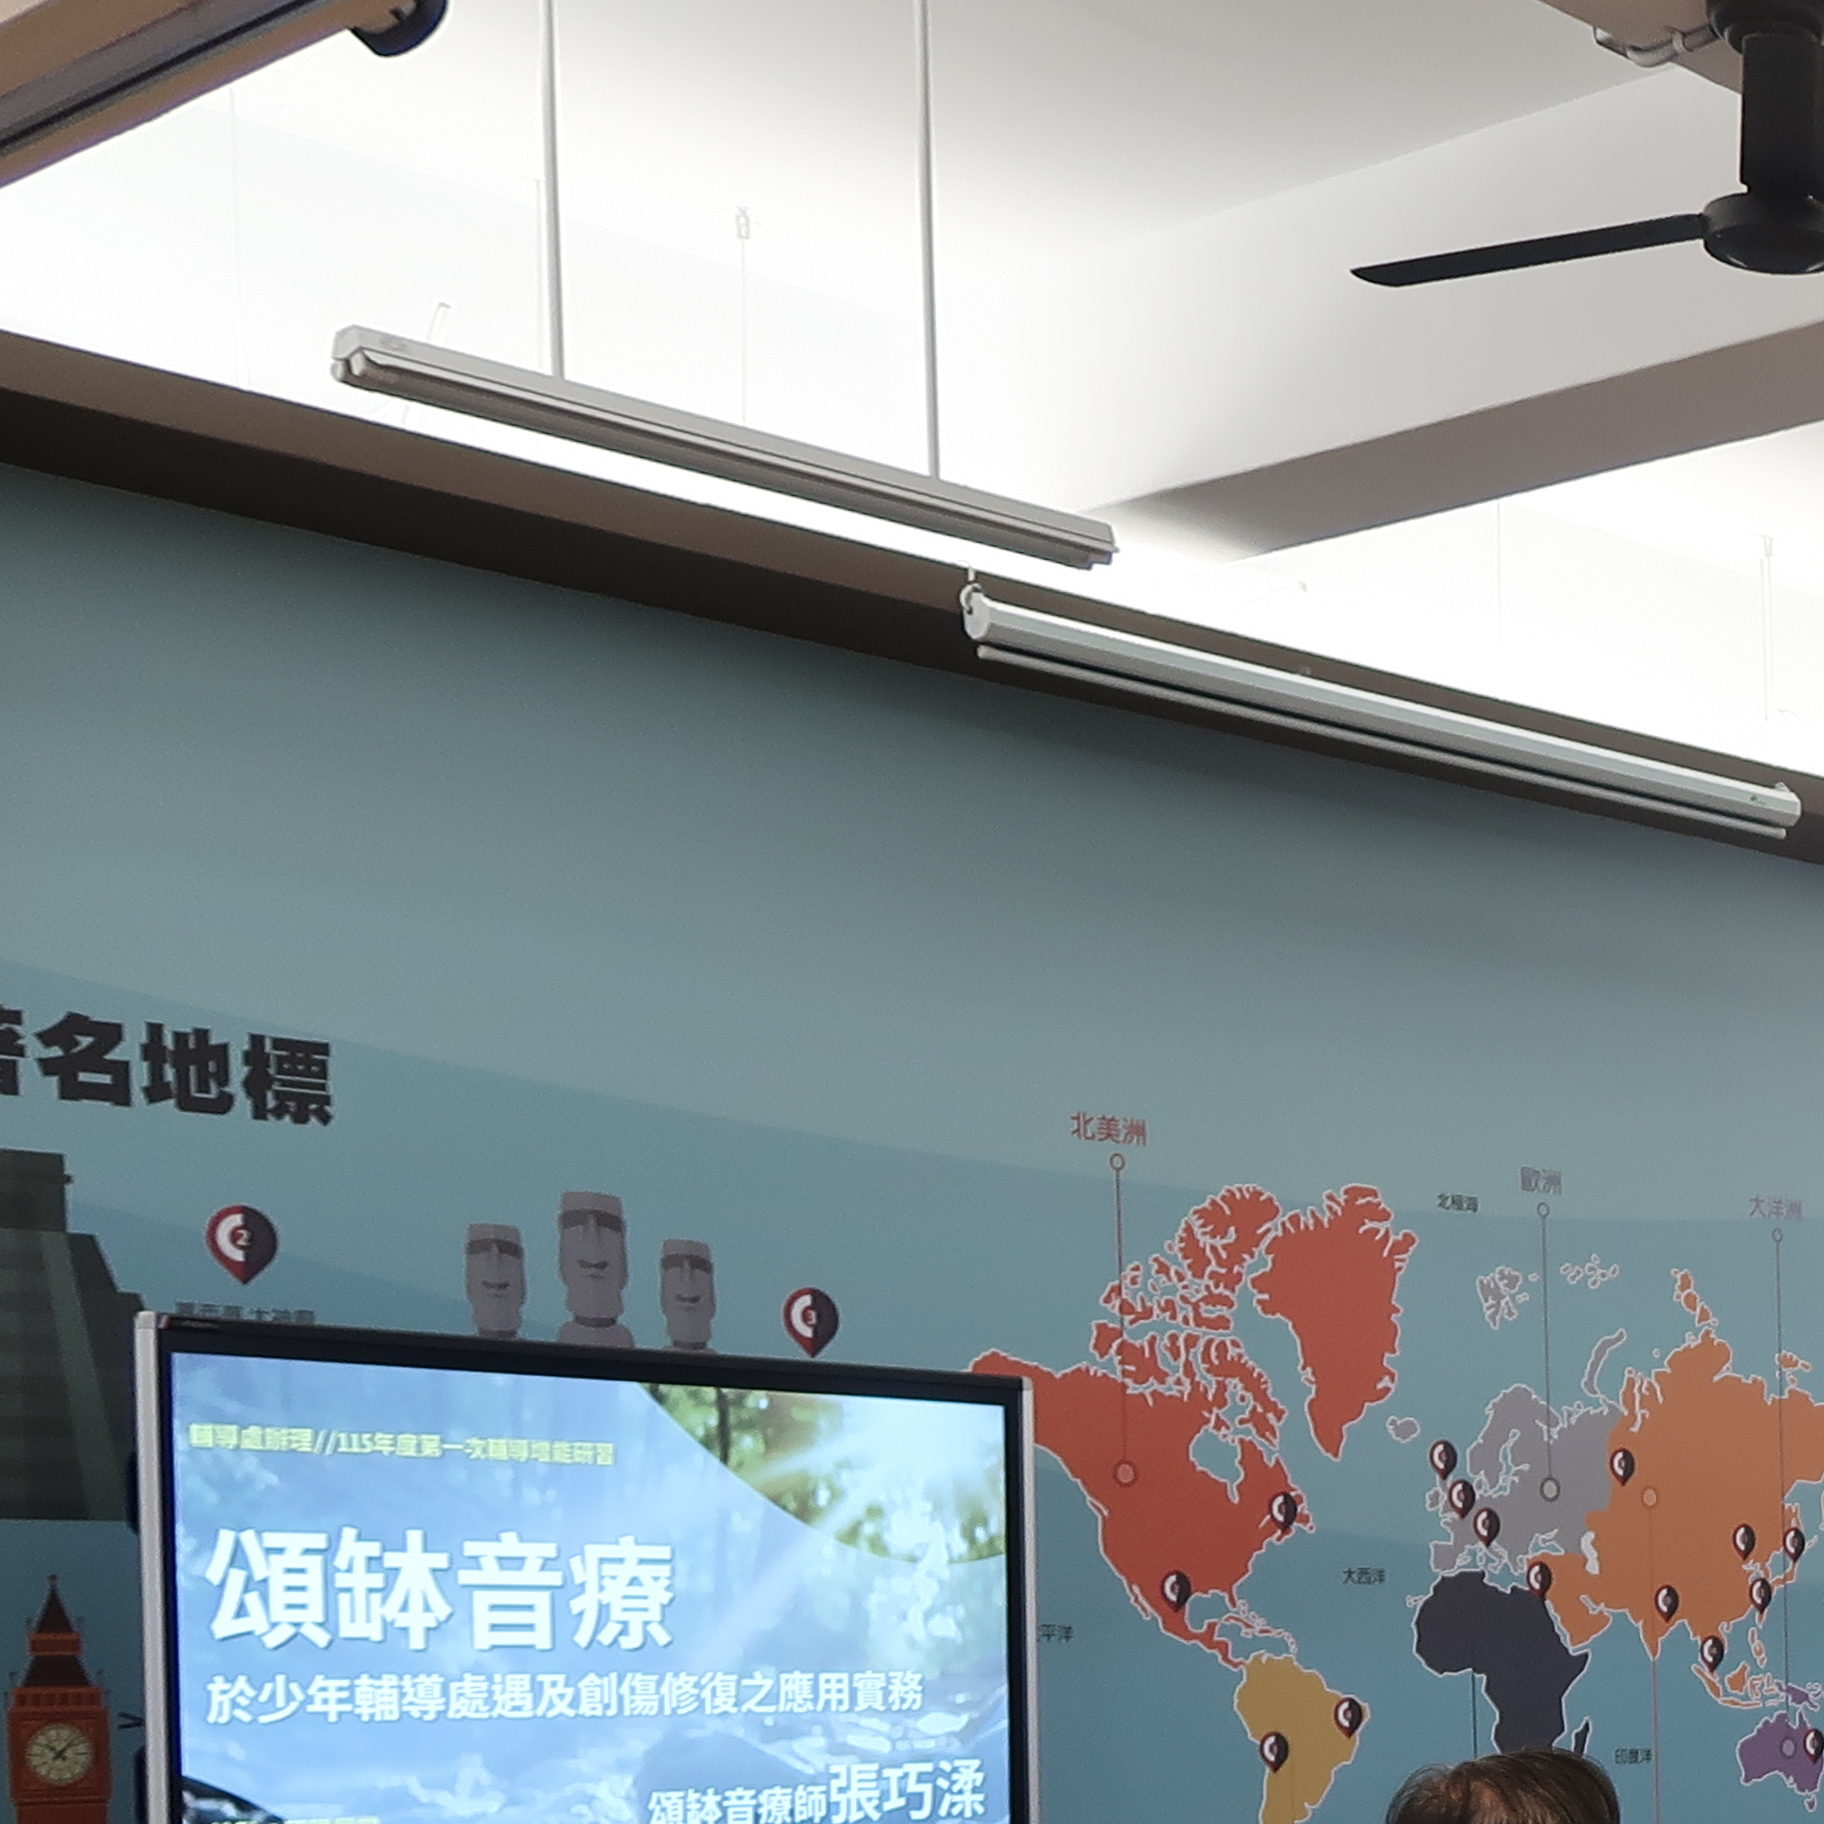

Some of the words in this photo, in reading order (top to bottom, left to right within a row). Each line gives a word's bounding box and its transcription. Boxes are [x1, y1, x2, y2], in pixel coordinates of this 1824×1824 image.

[0, 1008, 334, 1127] 名地標
[1070, 1110, 1148, 1147] 北美洲
[205, 1527, 675, 1650] 頌缽音療
